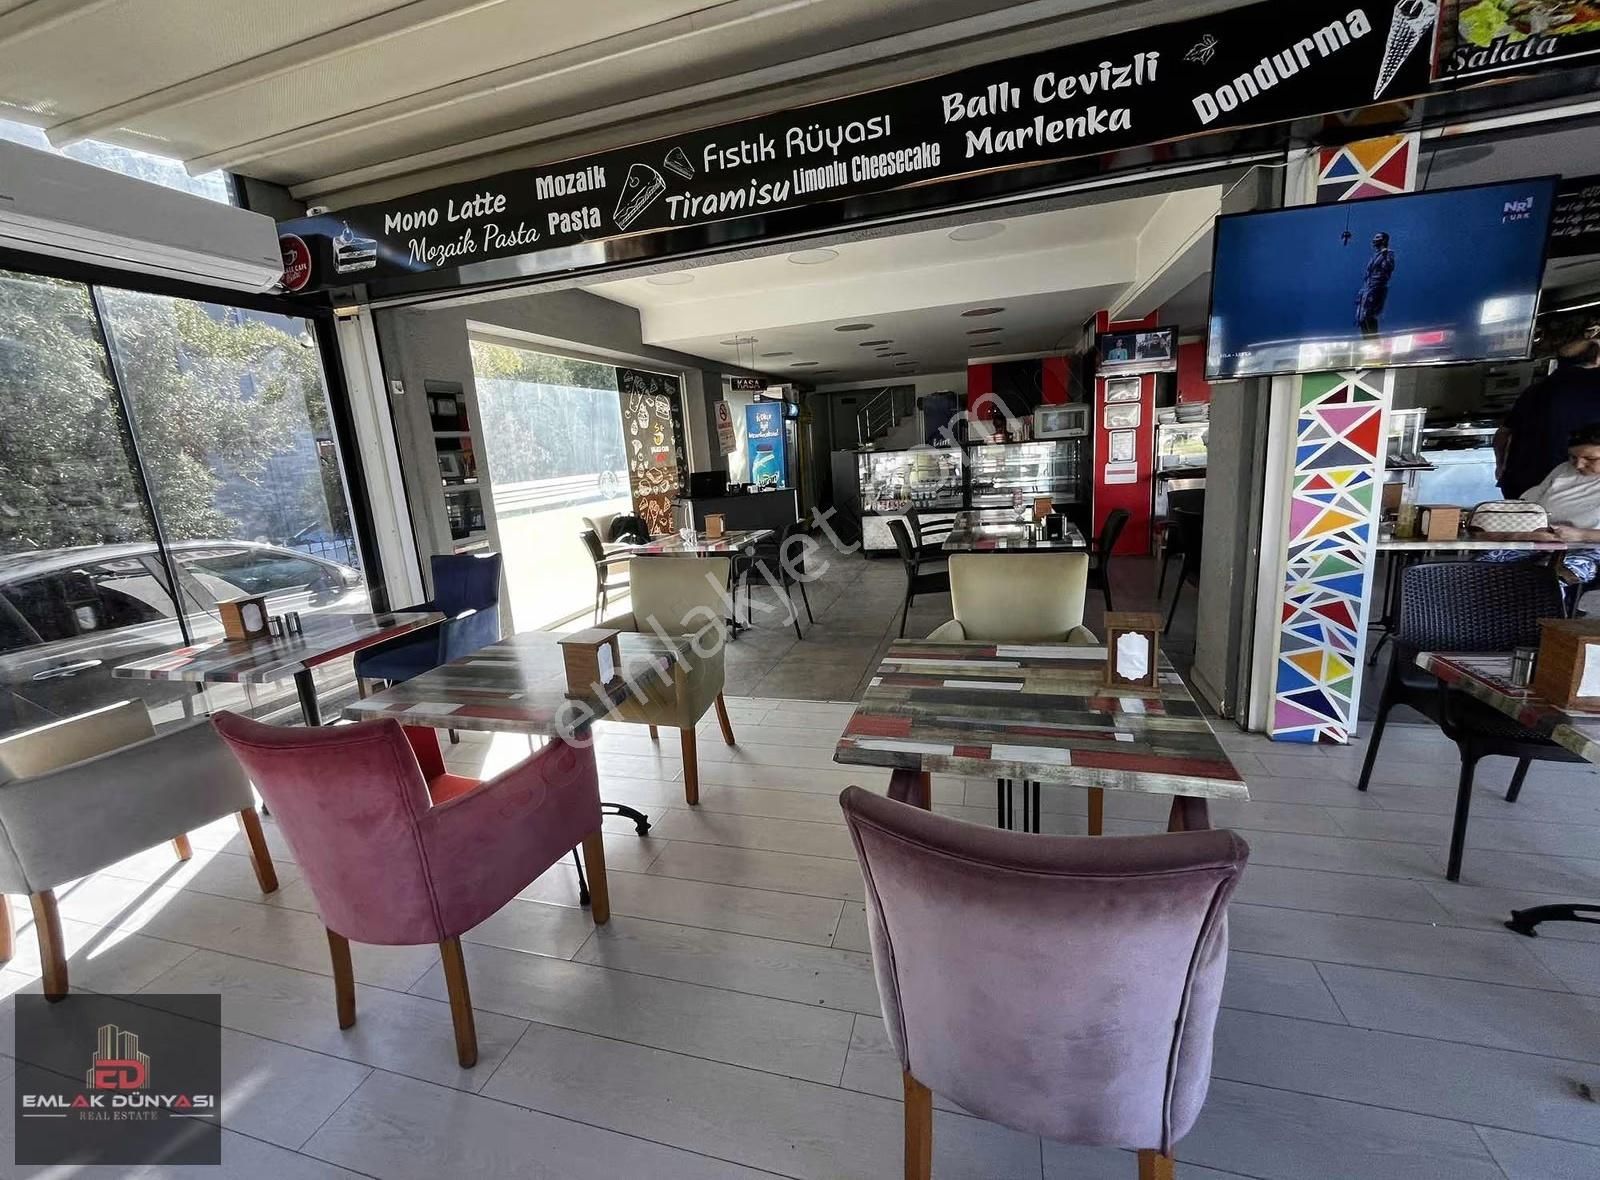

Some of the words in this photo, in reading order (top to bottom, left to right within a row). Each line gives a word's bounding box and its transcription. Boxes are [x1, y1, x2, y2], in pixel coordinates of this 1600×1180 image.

[1192, 9, 1371, 124] Dondurma
[1446, 37, 1558, 72] Salata
[942, 82, 1020, 124] Ballı
[1034, 52, 1159, 103] Cevizli
[704, 133, 775, 172] Fıstık
[786, 115, 890, 157] Rüyası
[966, 106, 1131, 158] Marlenka
[536, 166, 606, 200] Mozaik
[793, 161, 847, 194] Limonlu
[852, 142, 940, 182] Cheesecake
[385, 208, 438, 235] Mono
[448, 192, 506, 222] Latte
[548, 207, 601, 235] Pasta
[666, 180, 790, 220] Tiramisu
[1503, 196, 1534, 212] NR1
[408, 228, 477, 268] Mozaik
[484, 222, 540, 251] Pasta
[737, 379, 761, 389] KASA
